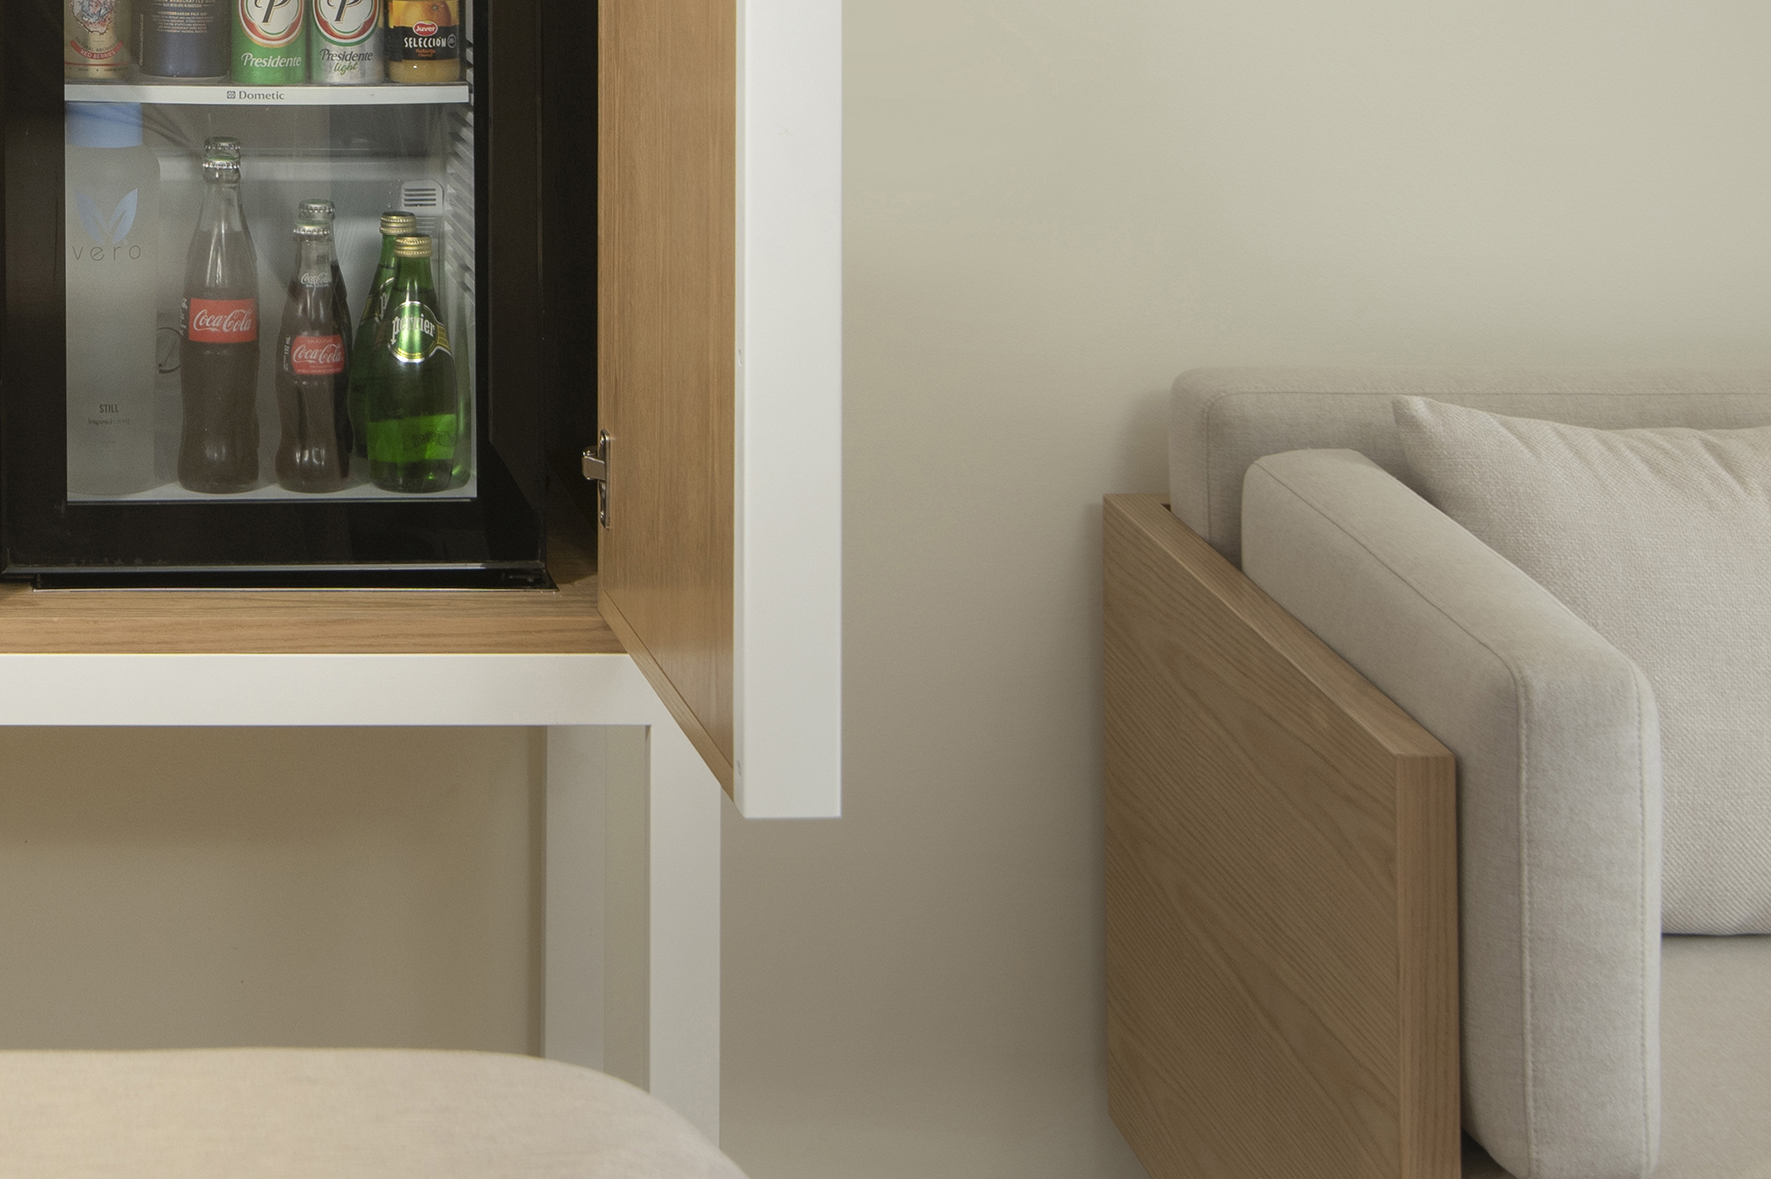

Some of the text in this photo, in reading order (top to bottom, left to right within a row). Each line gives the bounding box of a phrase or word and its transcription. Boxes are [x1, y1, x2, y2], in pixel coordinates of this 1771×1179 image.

[403, 36, 447, 48] SELECCIÓN
[240, 52, 302, 68] Presidente
[320, 48, 374, 61] Presidente
[333, 60, 359, 75] light
[239, 90, 285, 100] Dometic
[72, 244, 141, 261] vero
[192, 308, 253, 332] Coca-Cola
[390, 313, 436, 345] perrier
[293, 343, 342, 364] Coca-Cola
[99, 403, 119, 414] STILL
